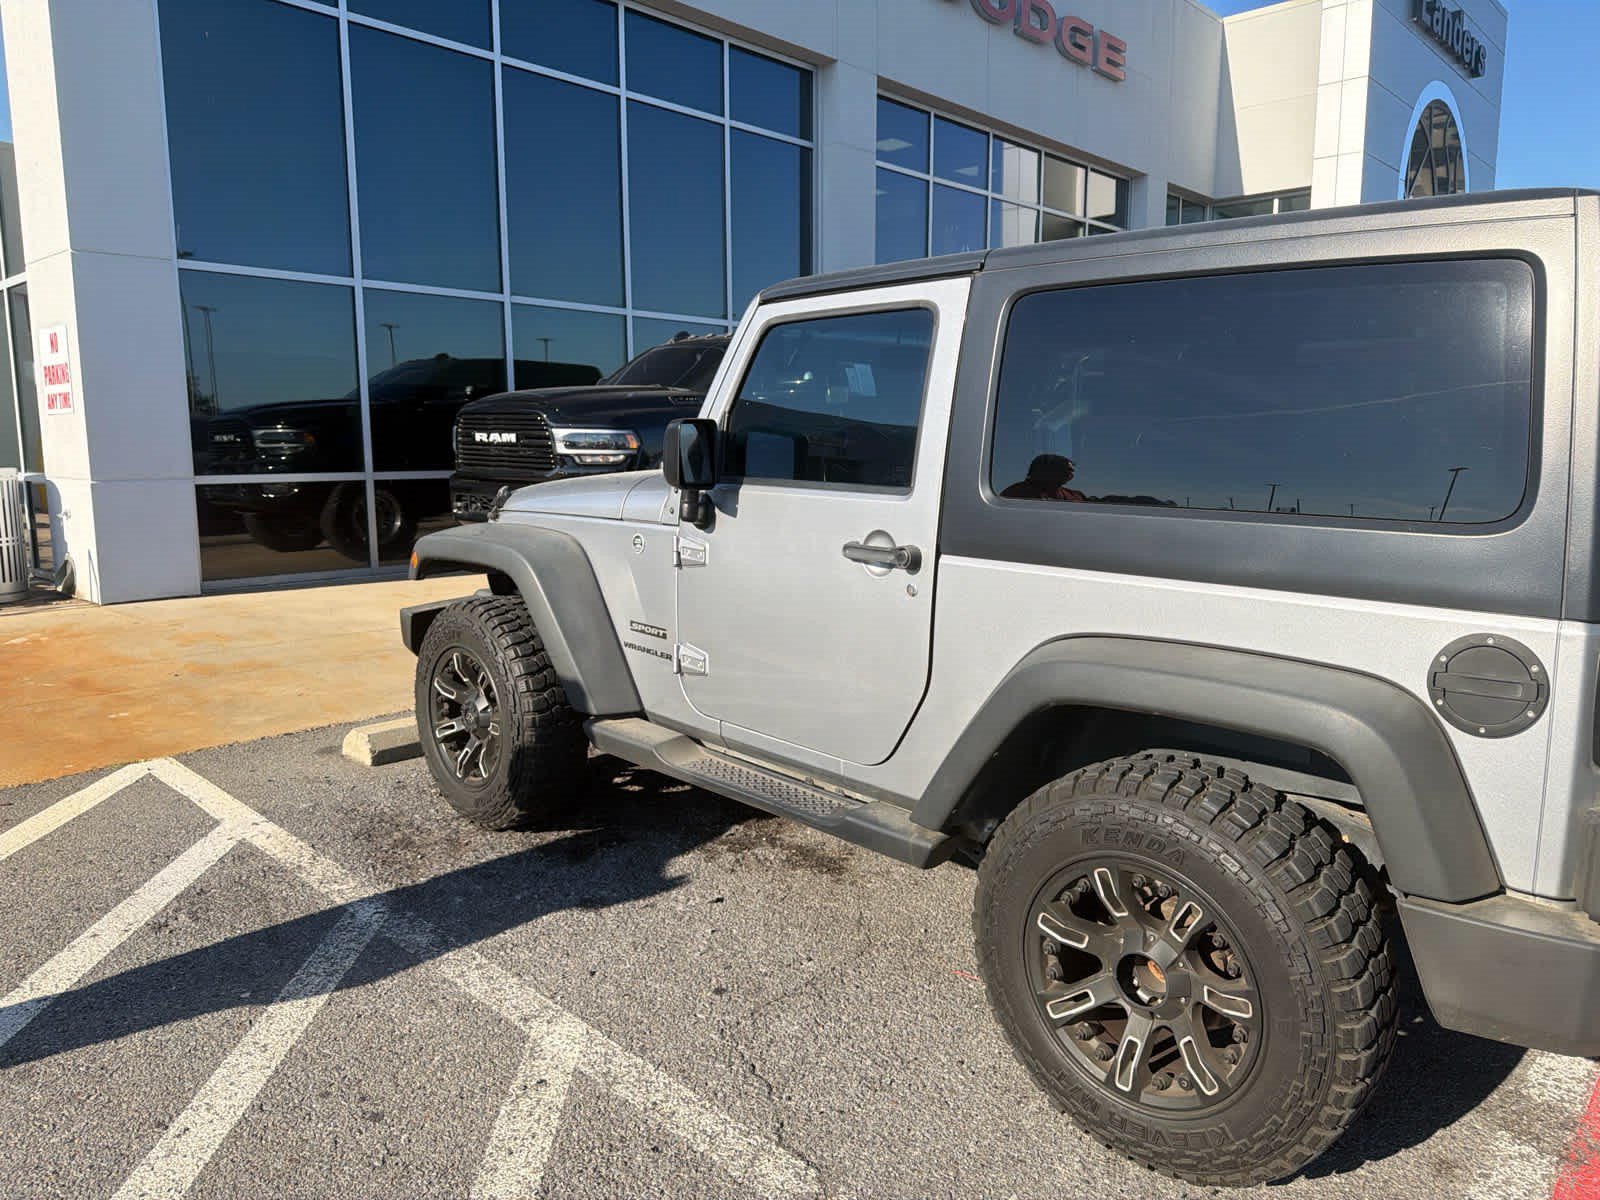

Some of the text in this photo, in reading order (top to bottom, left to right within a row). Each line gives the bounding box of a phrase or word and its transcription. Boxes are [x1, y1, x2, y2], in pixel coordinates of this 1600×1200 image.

[937, 0, 1127, 82] ODGE
[49, 332, 59, 353] NO
[43, 362, 70, 386] PARKING
[47, 391, 71, 410] ANY TIME
[474, 432, 517, 443] RAM
[630, 620, 667, 640] SPORT
[623, 641, 673, 661] WRANGLER
[1080, 825, 1185, 867] KENDA
